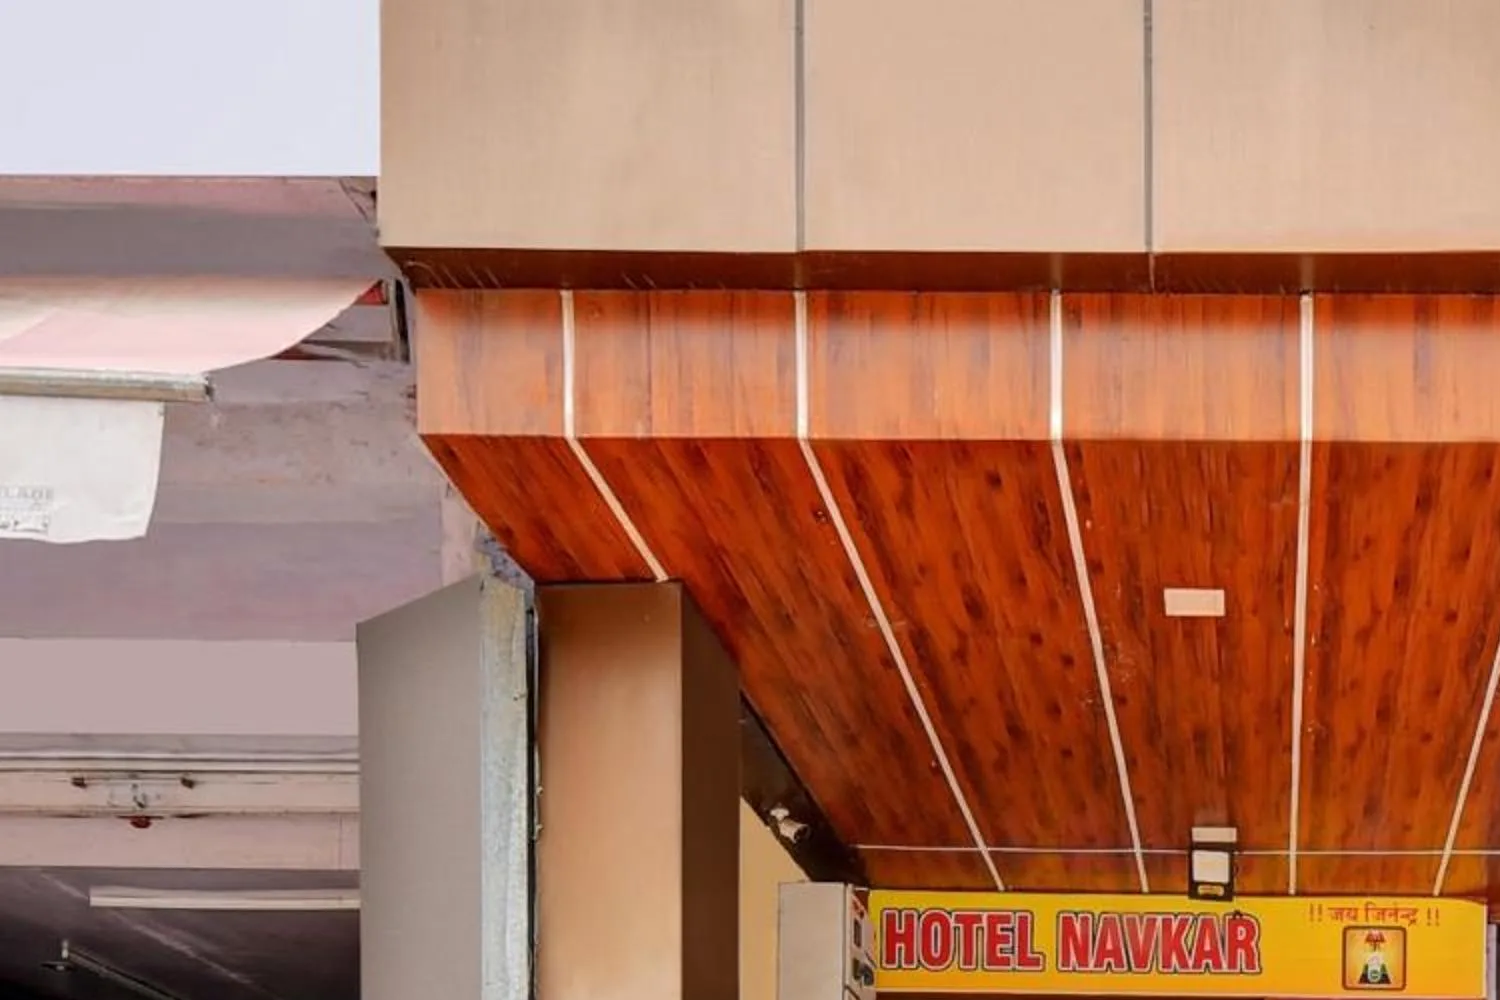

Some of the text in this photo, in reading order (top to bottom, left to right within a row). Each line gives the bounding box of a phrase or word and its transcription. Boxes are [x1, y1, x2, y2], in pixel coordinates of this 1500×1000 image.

[1327, 906, 1359, 921] जय
[881, 908, 1262, 974] HOTEL NAVKAR
